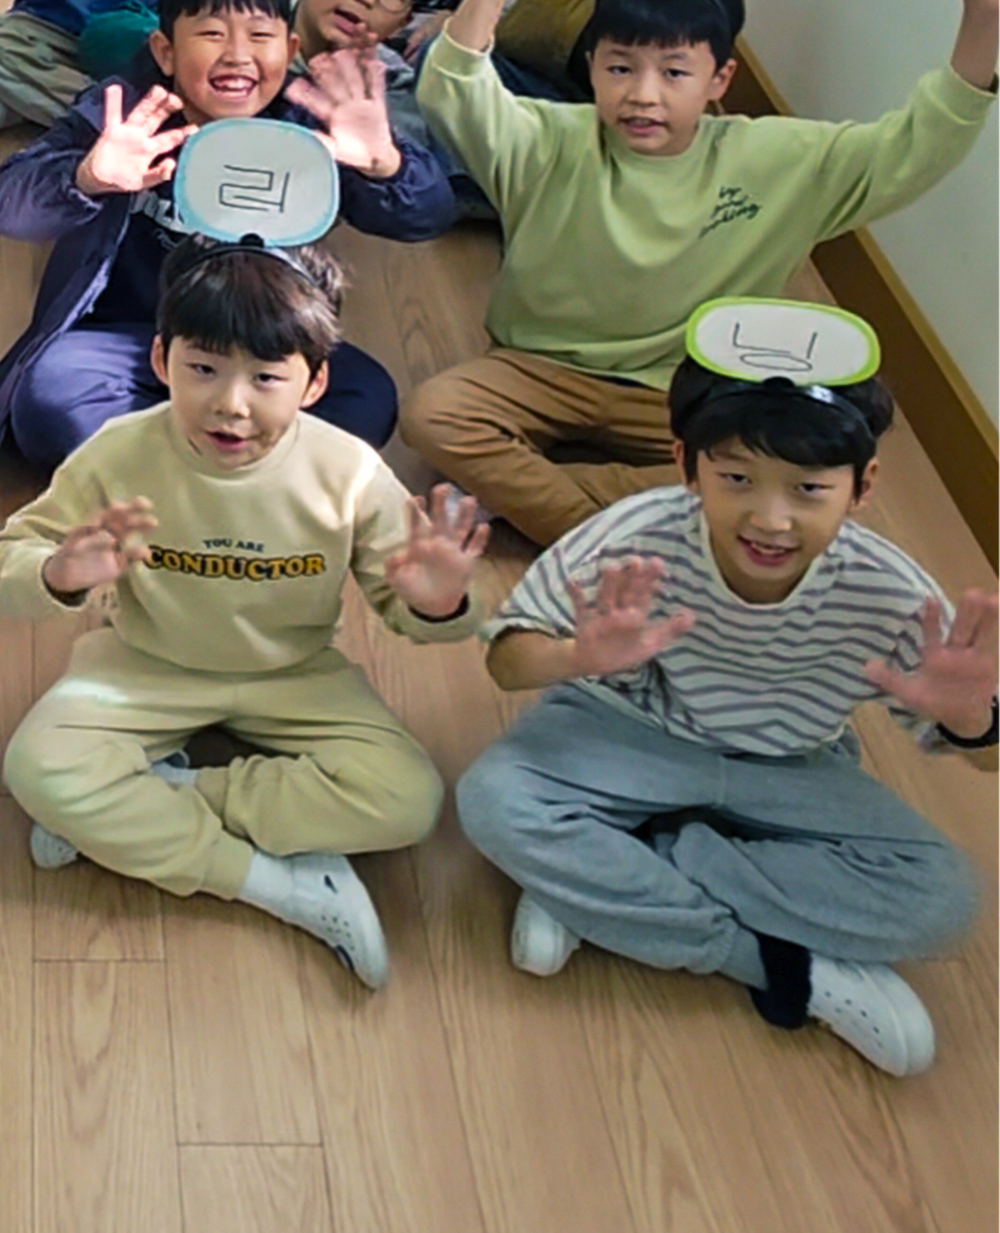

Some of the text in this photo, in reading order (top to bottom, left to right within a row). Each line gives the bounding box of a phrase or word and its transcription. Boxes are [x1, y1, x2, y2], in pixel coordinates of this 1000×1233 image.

[203, 538, 265, 553] YOU ARE
[143, 544, 326, 581] CONDUCTOR
